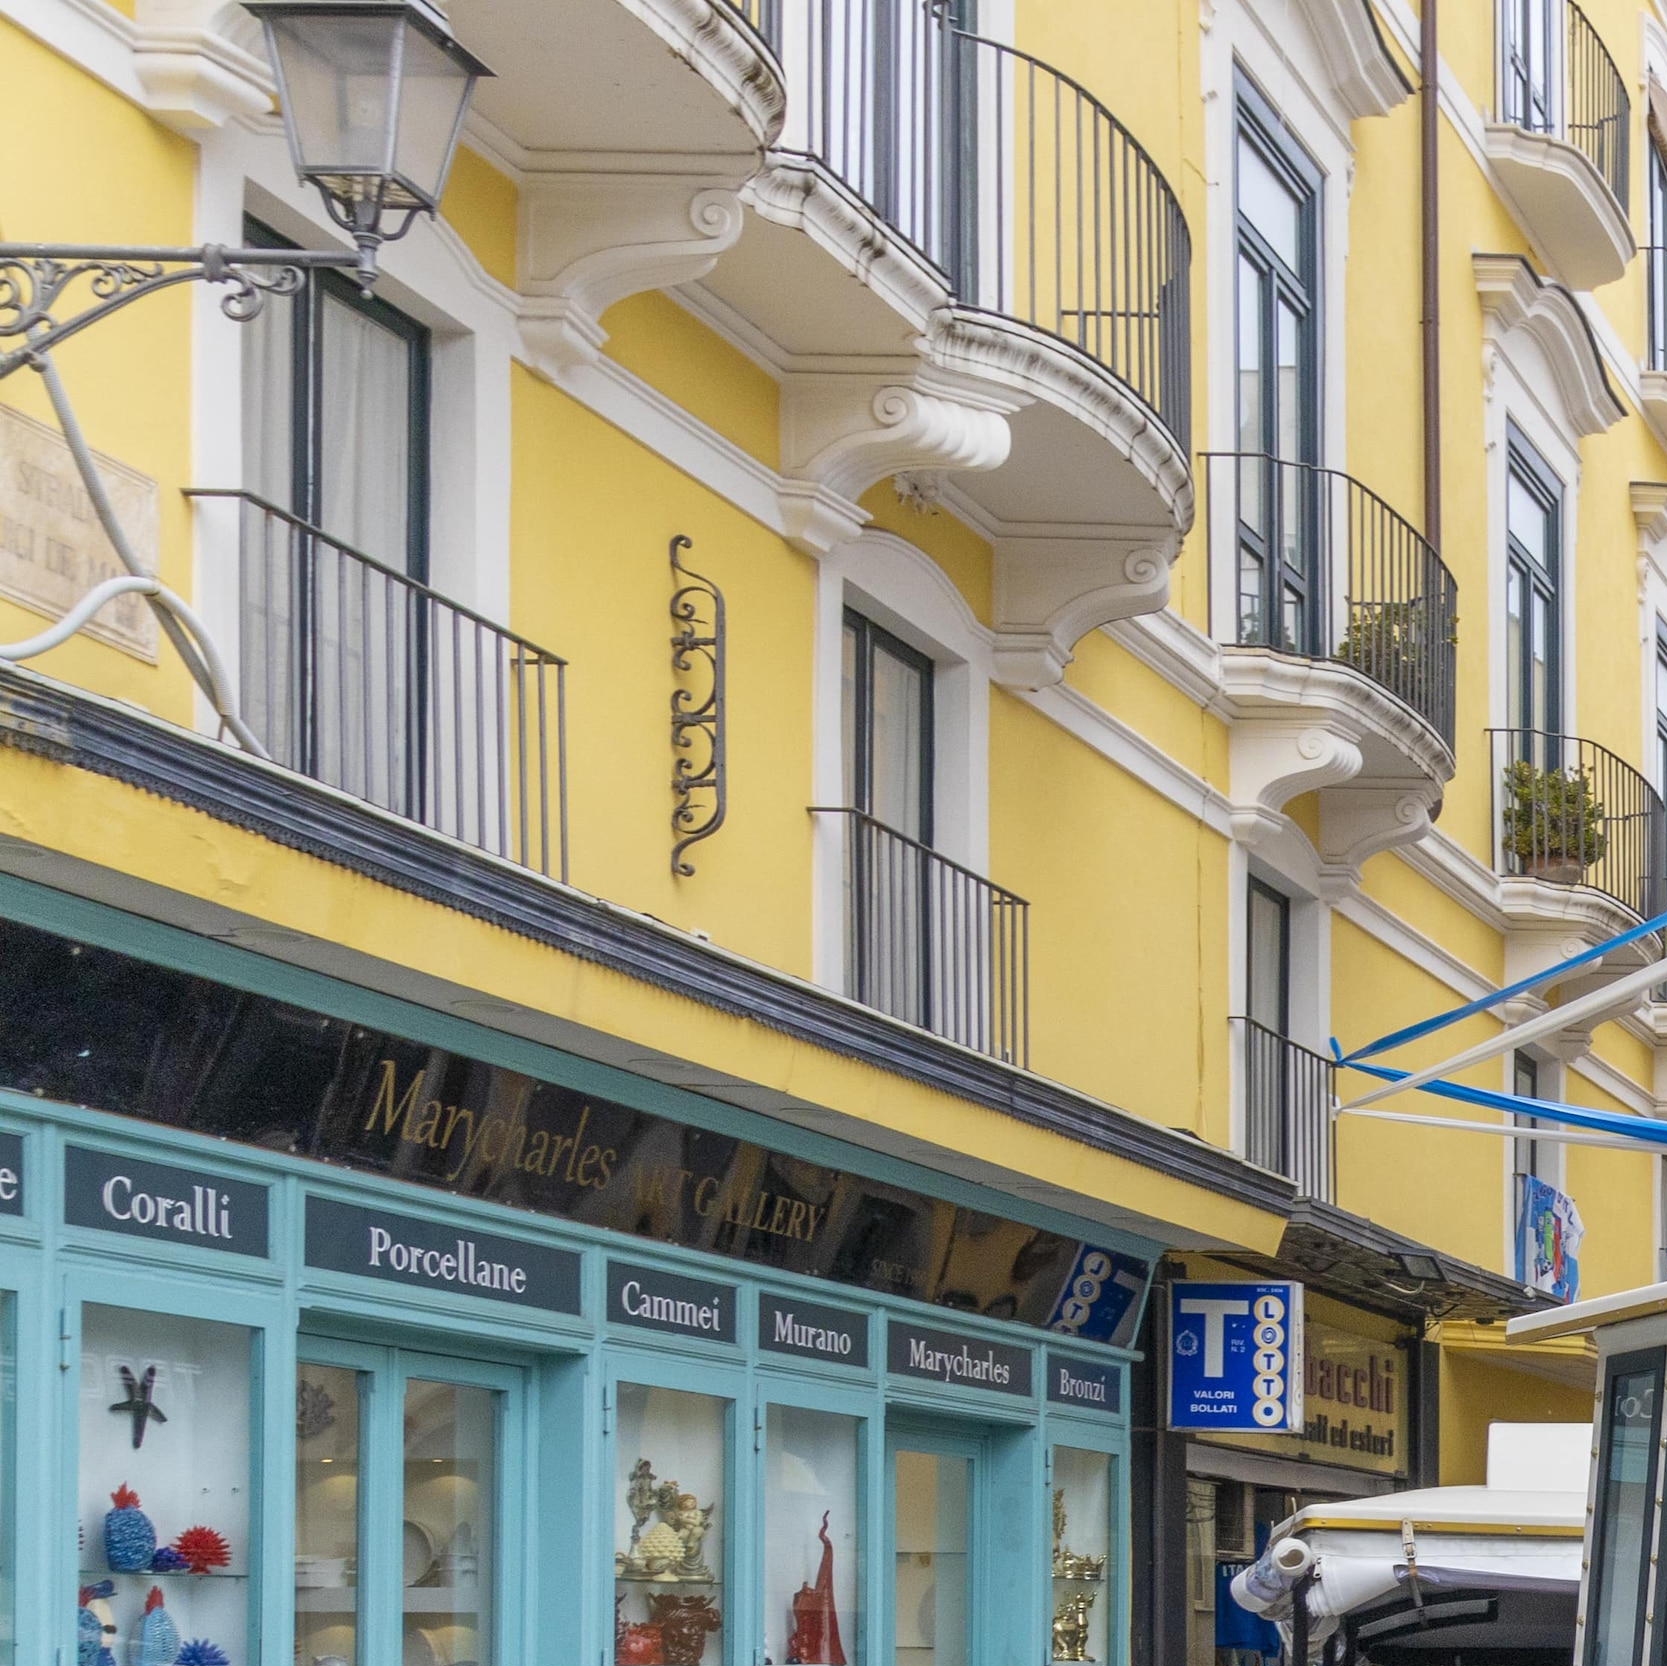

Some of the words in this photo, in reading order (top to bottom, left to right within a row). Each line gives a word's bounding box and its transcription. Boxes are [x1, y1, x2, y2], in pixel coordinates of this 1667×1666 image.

[364, 1059, 618, 1190] Marycharles
[693, 1174, 827, 1243] GALLERY
[102, 1175, 234, 1240] Coralli
[368, 1226, 528, 1294] Porcellane
[621, 1280, 721, 1333] Cammei
[773, 1310, 853, 1356] Murano
[909, 1337, 1011, 1383] Marycharles
[1058, 1368, 1106, 1402] Bronzi
[1193, 1389, 1235, 1400] VALORI
[1304, 1353, 1395, 1415] bacchi
[1190, 1403, 1238, 1414] BOLLATI
[1350, 1425, 1394, 1457] esteri
